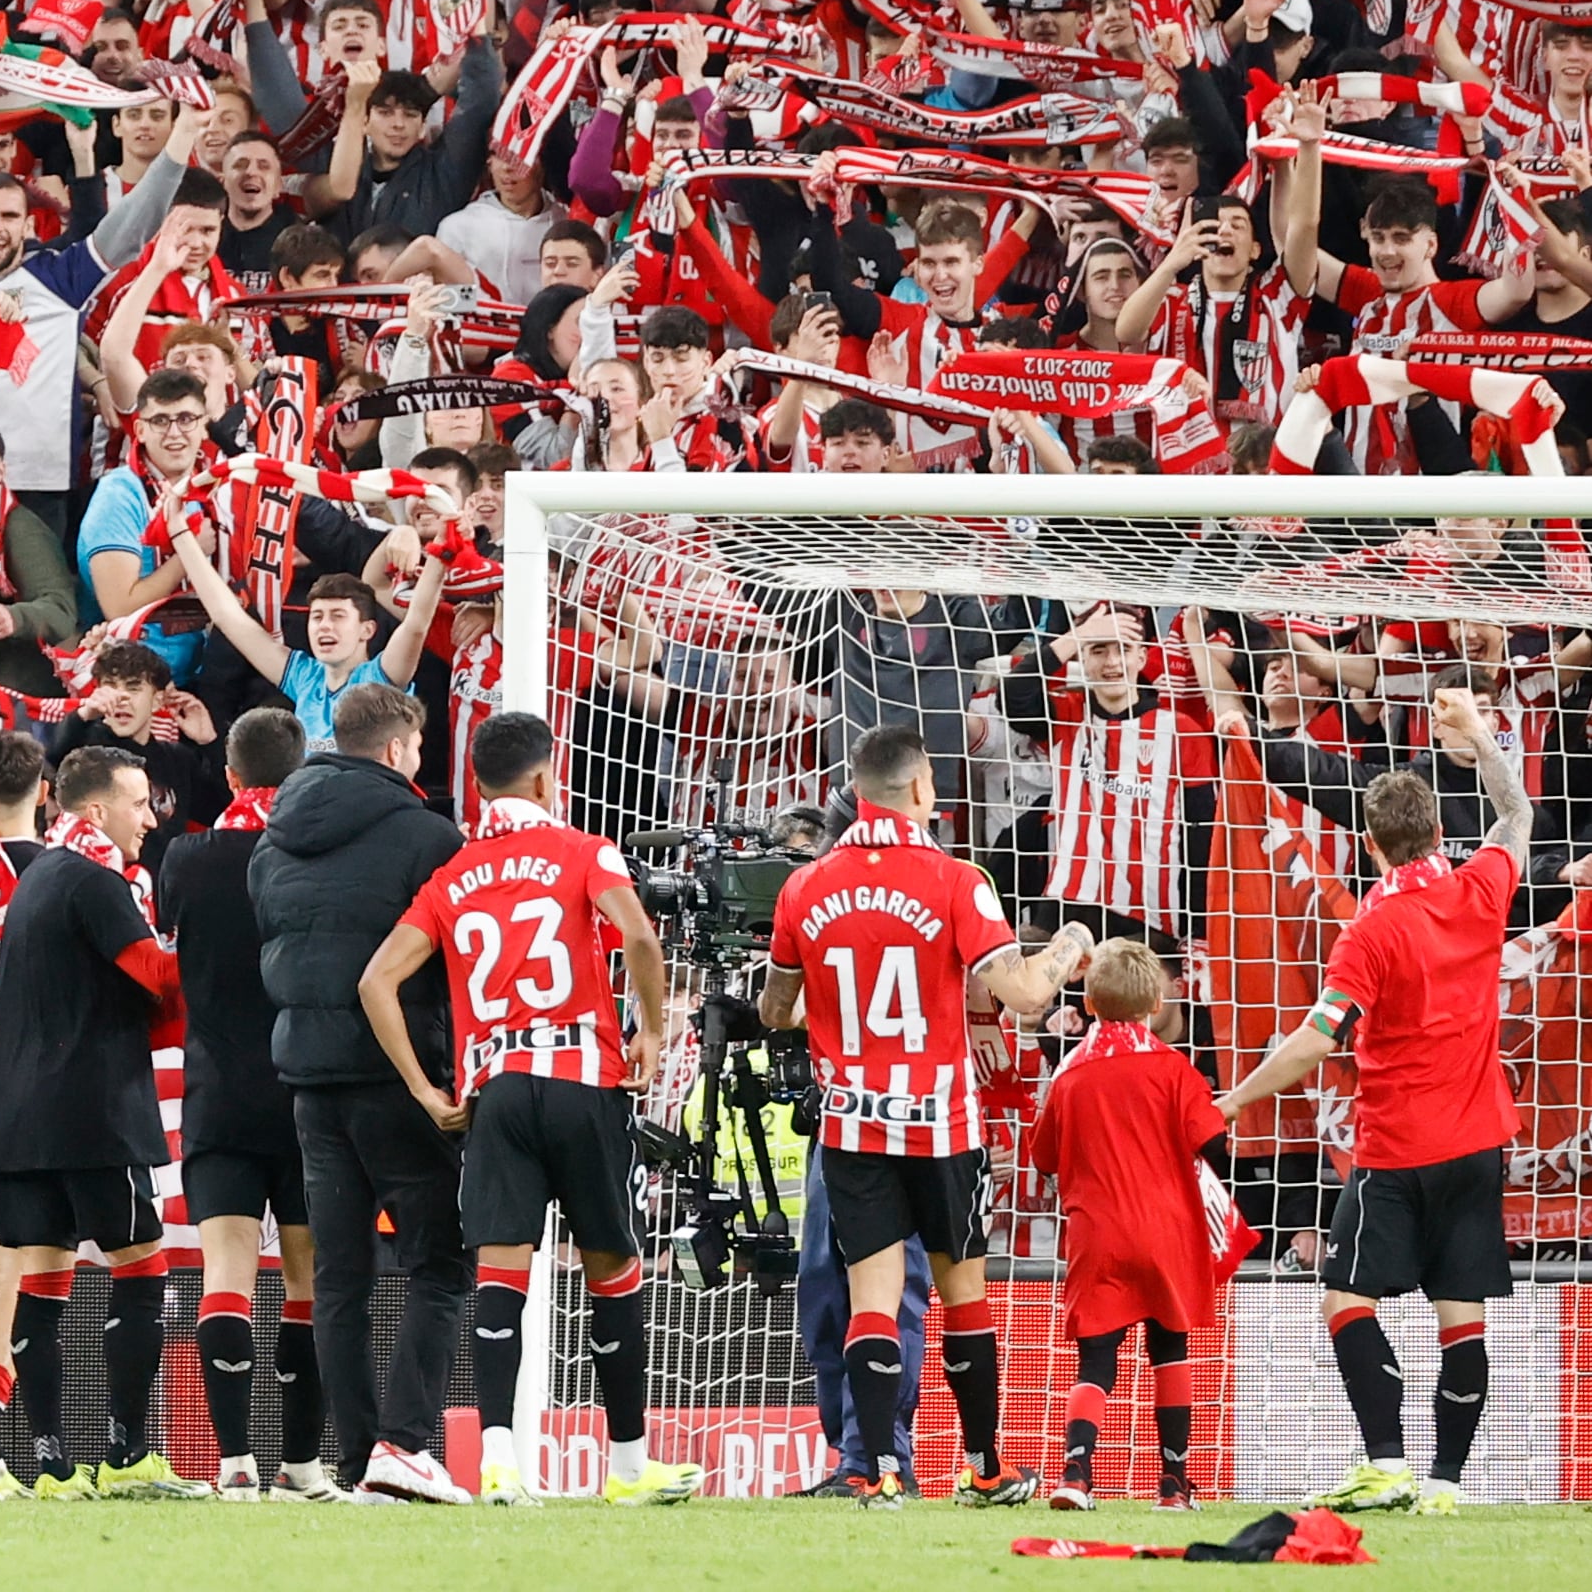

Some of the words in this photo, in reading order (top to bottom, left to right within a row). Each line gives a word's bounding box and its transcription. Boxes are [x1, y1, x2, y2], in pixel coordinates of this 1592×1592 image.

[939, 371, 1061, 405] Bihotzean
[1060, 380, 1113, 406] Club
[1022, 357, 1113, 379] 2002-2012
[446, 863, 494, 906] ADU
[500, 856, 562, 887] ARES
[800, 891, 853, 942] DANI
[855, 886, 943, 943] GARCIA
[452, 895, 575, 1024] 23
[823, 946, 929, 1055] 14
[473, 1023, 581, 1071] DIGI
[824, 1086, 936, 1122] DIGI
